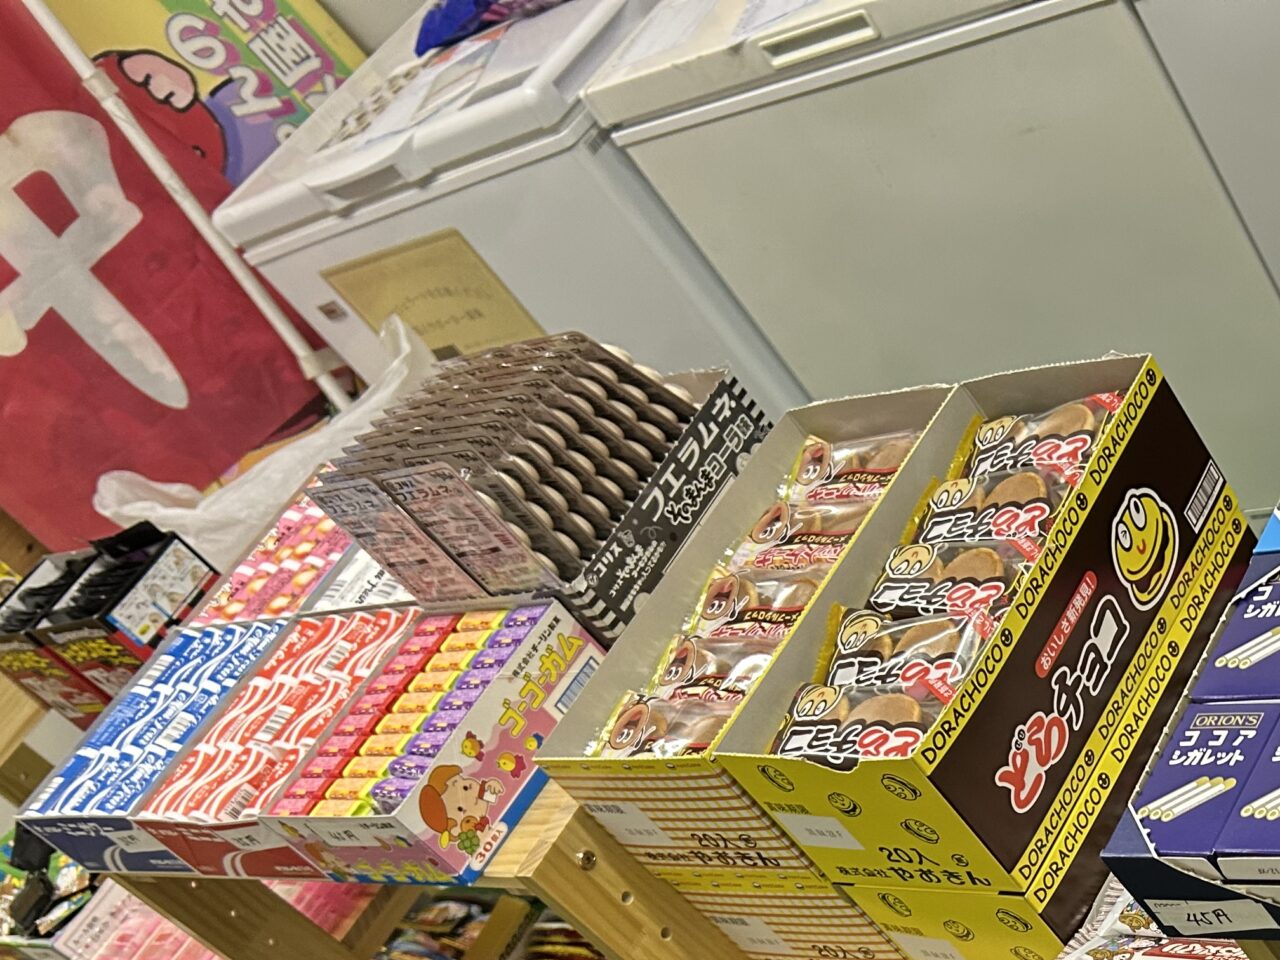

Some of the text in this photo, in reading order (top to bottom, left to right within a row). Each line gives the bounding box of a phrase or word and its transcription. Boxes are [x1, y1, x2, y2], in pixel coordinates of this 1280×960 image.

[1090, 382, 1149, 486] DORACHOCO
[1016, 509, 1080, 620] DORACHOCO
[1169, 508, 1226, 609] DORACHOCO
[1180, 532, 1237, 633] DORACHOCO
[498, 633, 586, 738] ゴーゴーガム
[923, 647, 1003, 765] DORACHOCO
[1098, 636, 1159, 740] DORACHOCO
[1111, 658, 1172, 763] DORACHOCO
[1195, 714, 1258, 727] ORION'S
[1169, 748, 1245, 766] シガレット
[1180, 730, 1256, 747] ココア
[878, 847, 940, 866] 20入
[1019, 764, 1085, 880] DORACHOCO
[1034, 787, 1101, 903] DORACHOCO
